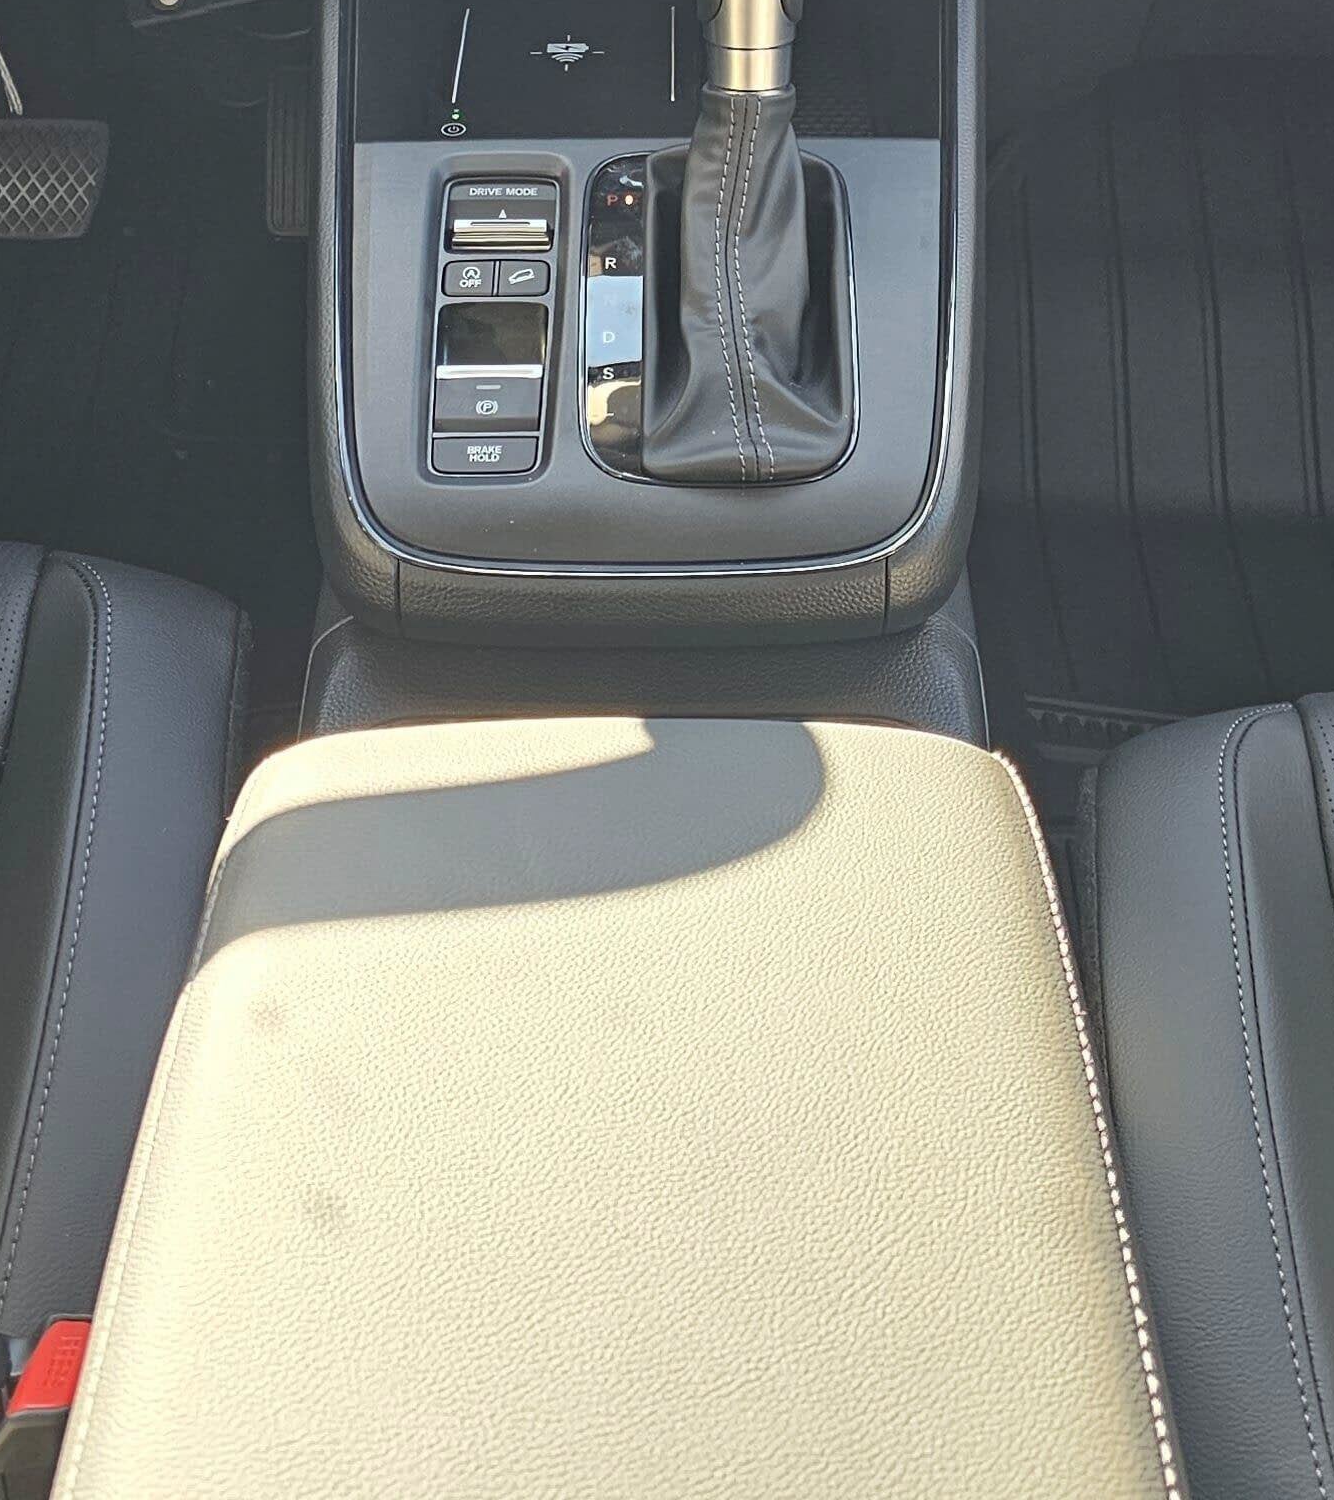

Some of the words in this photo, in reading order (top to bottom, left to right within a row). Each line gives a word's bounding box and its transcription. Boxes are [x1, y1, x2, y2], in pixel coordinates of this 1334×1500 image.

[469, 188, 503, 197] DRIVE
[505, 188, 539, 196] MODE
[607, 195, 618, 206] P
[605, 257, 617, 269] R
[459, 278, 482, 288] OFF
[603, 331, 616, 344] D
[602, 367, 615, 381] S
[466, 445, 502, 455] BRAKE
[469, 452, 500, 463] HOLD
